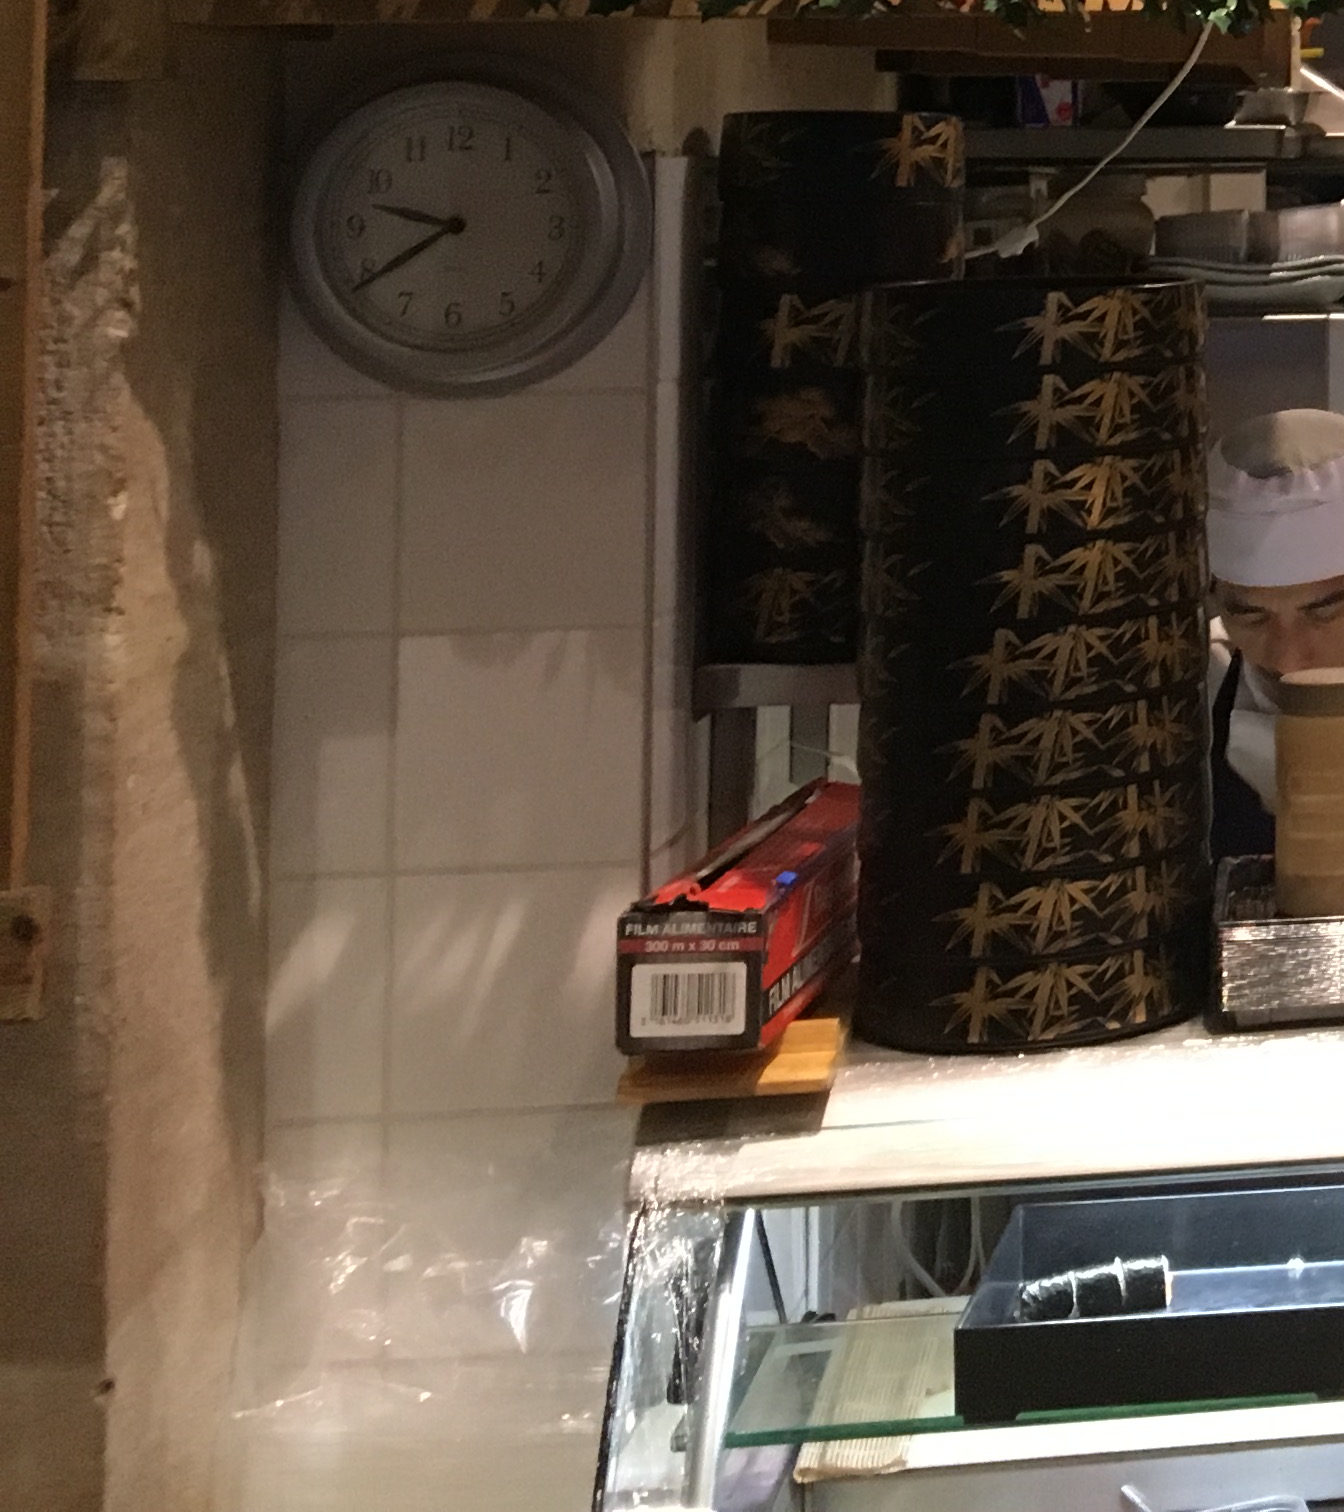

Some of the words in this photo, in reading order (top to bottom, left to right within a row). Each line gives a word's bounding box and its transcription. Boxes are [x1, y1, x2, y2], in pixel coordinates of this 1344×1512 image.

[447, 126, 475, 152] 12
[625, 923, 659, 936] FILM
[662, 921, 757, 935] ALIMENTAIRE
